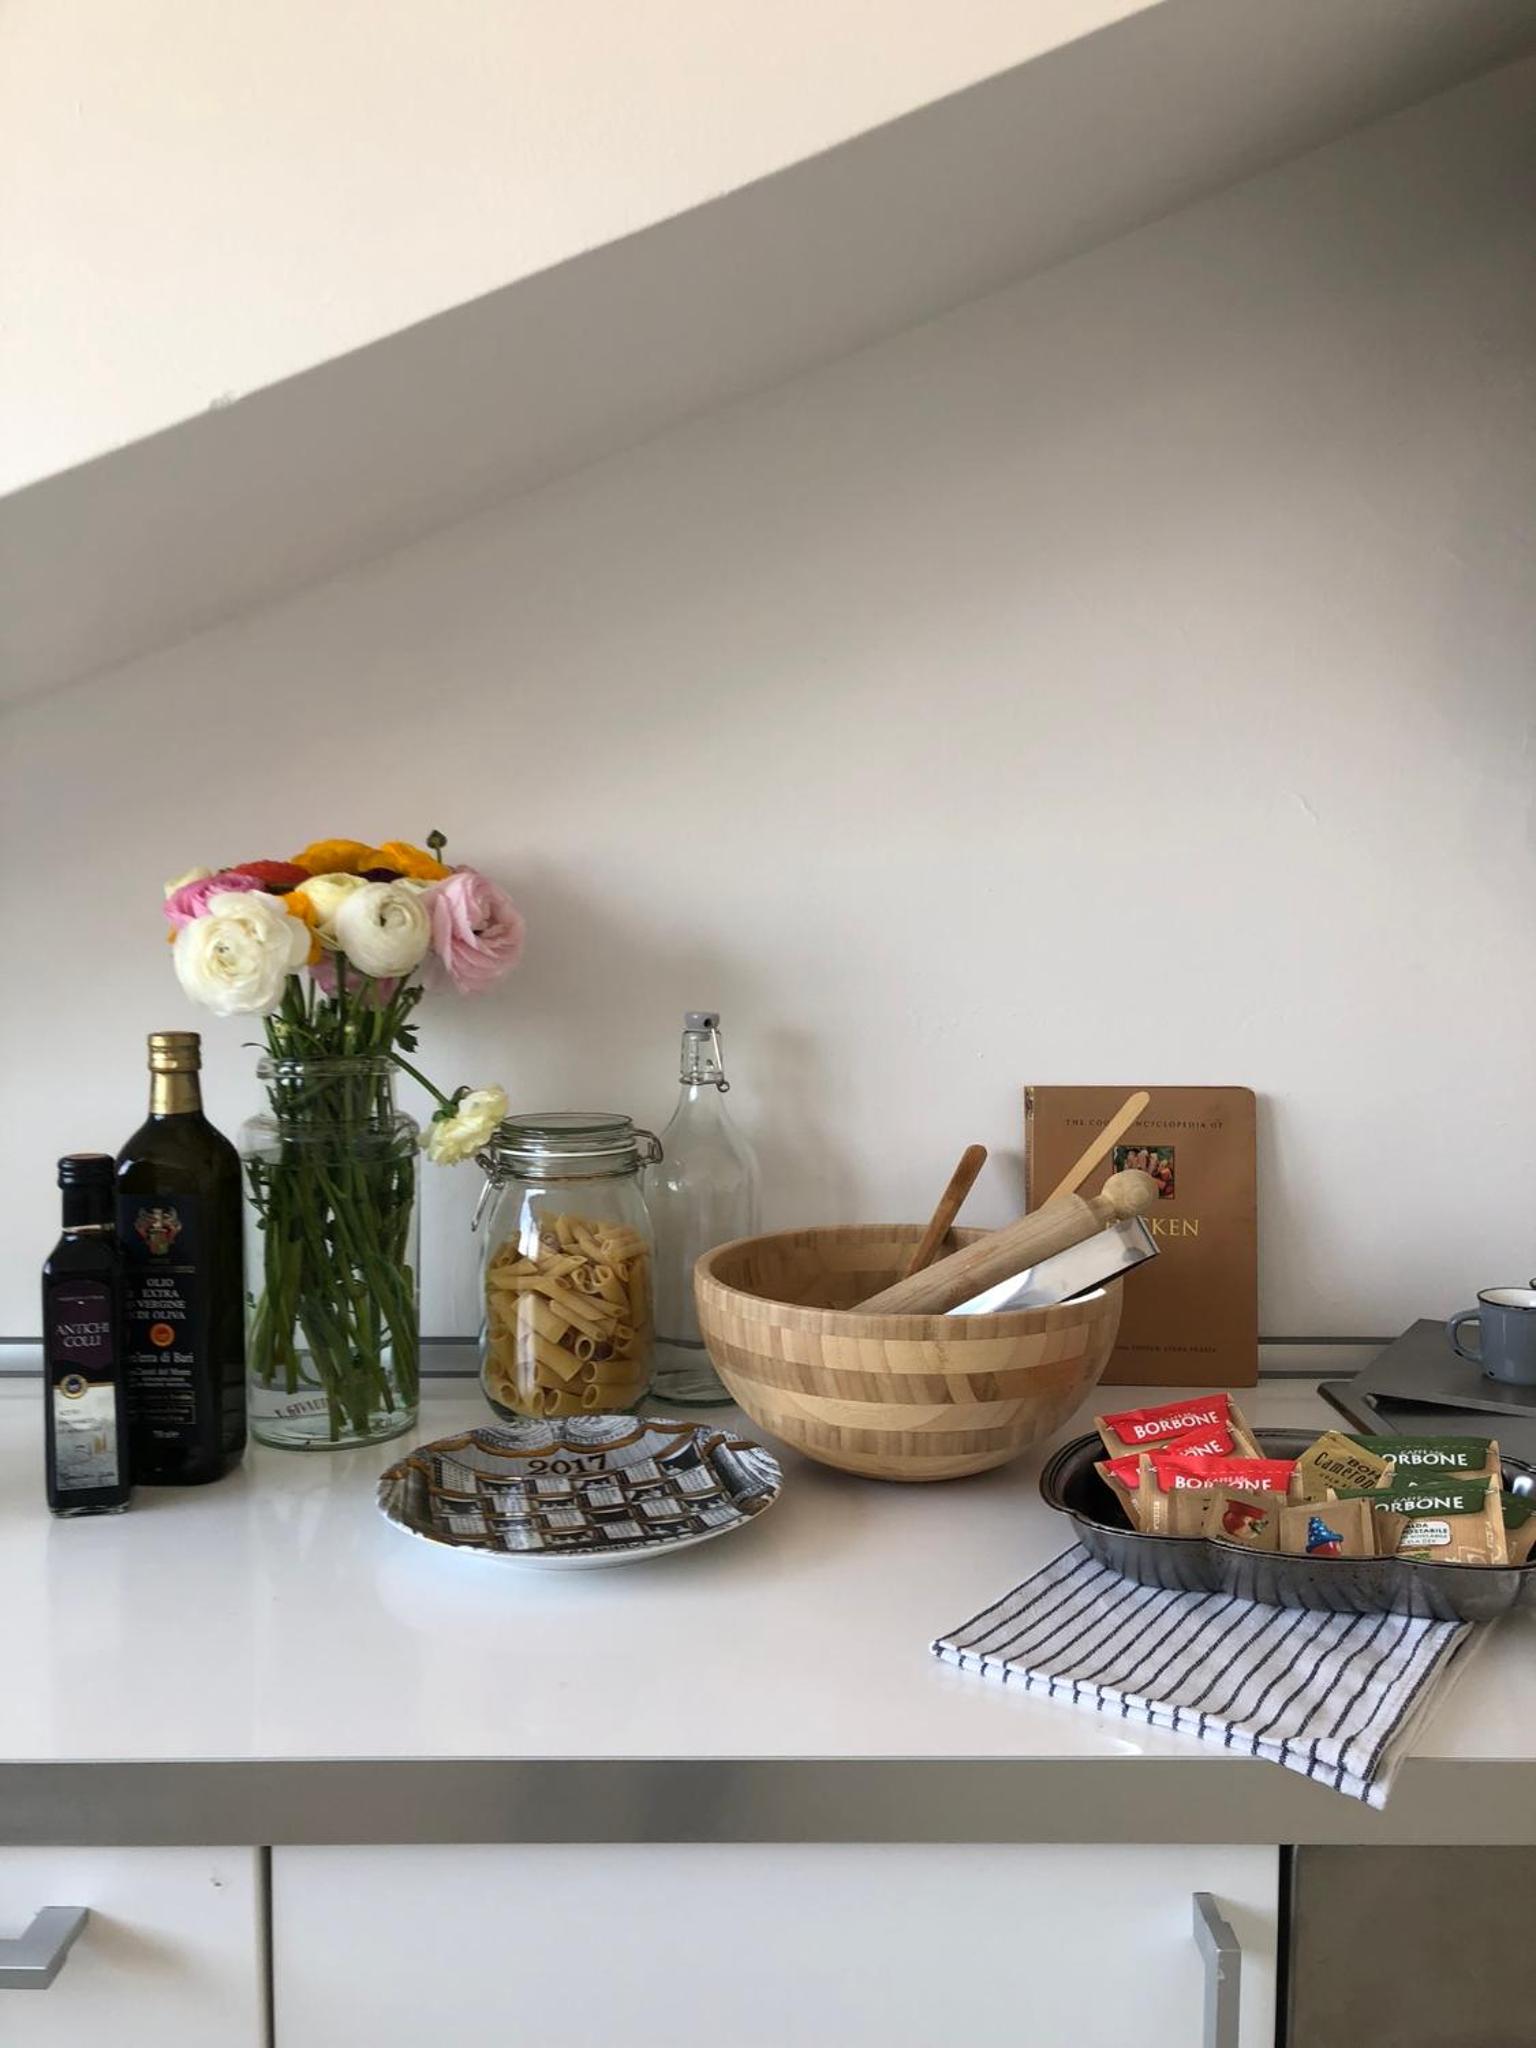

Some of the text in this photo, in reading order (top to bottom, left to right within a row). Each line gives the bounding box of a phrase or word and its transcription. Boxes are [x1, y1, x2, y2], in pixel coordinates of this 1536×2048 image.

[1066, 1118, 1085, 1127] THE
[1135, 1120, 1206, 1129] NCYCLOPEDIA
[145, 1278, 175, 1288] OLIO
[142, 1288, 180, 1298] EXTRA
[152, 1310, 187, 1320] OLIVA
[1133, 1411, 1220, 1439] BORBONE
[526, 1453, 606, 1475] 2017
[1382, 1453, 1468, 1467] ORBONE
[1314, 1451, 1376, 1490] Cameron
[1375, 1496, 1465, 1513] ORBONE
